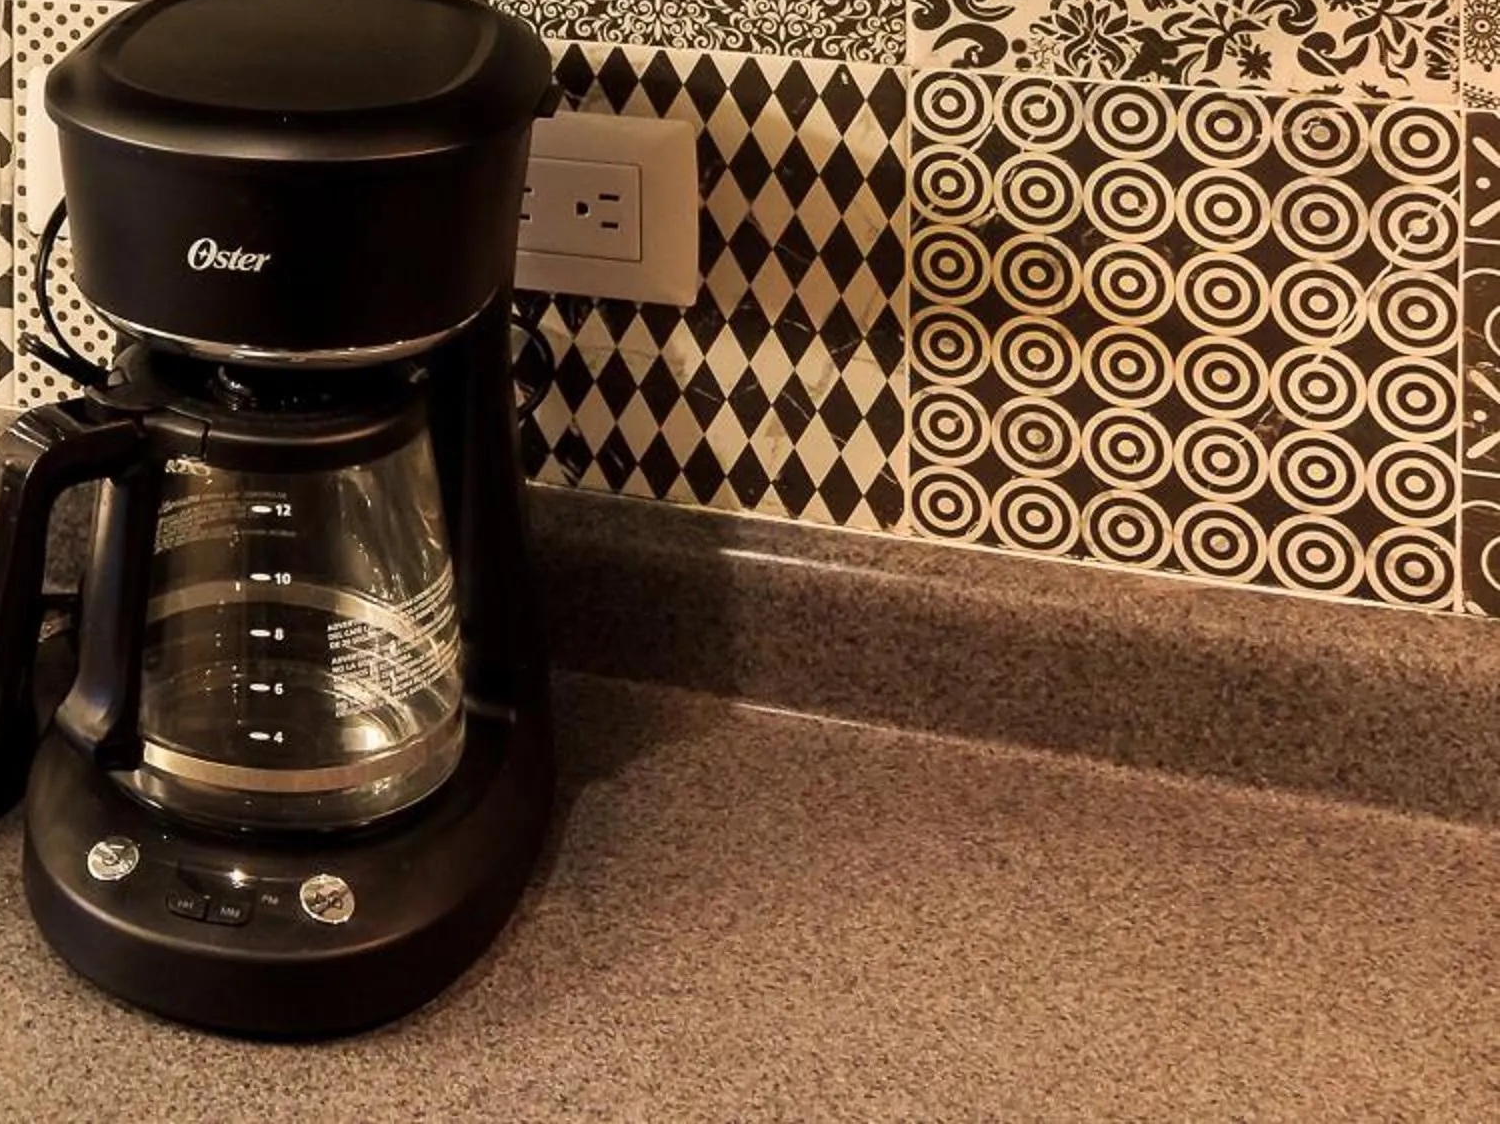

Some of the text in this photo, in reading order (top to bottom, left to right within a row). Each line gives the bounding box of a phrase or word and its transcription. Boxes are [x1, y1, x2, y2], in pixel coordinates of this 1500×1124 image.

[187, 237, 271, 272] Oster
[275, 503, 293, 517] 12
[275, 573, 292, 585] 10
[274, 627, 285, 641] 8
[273, 683, 284, 695] 6
[273, 731, 284, 744] 4
